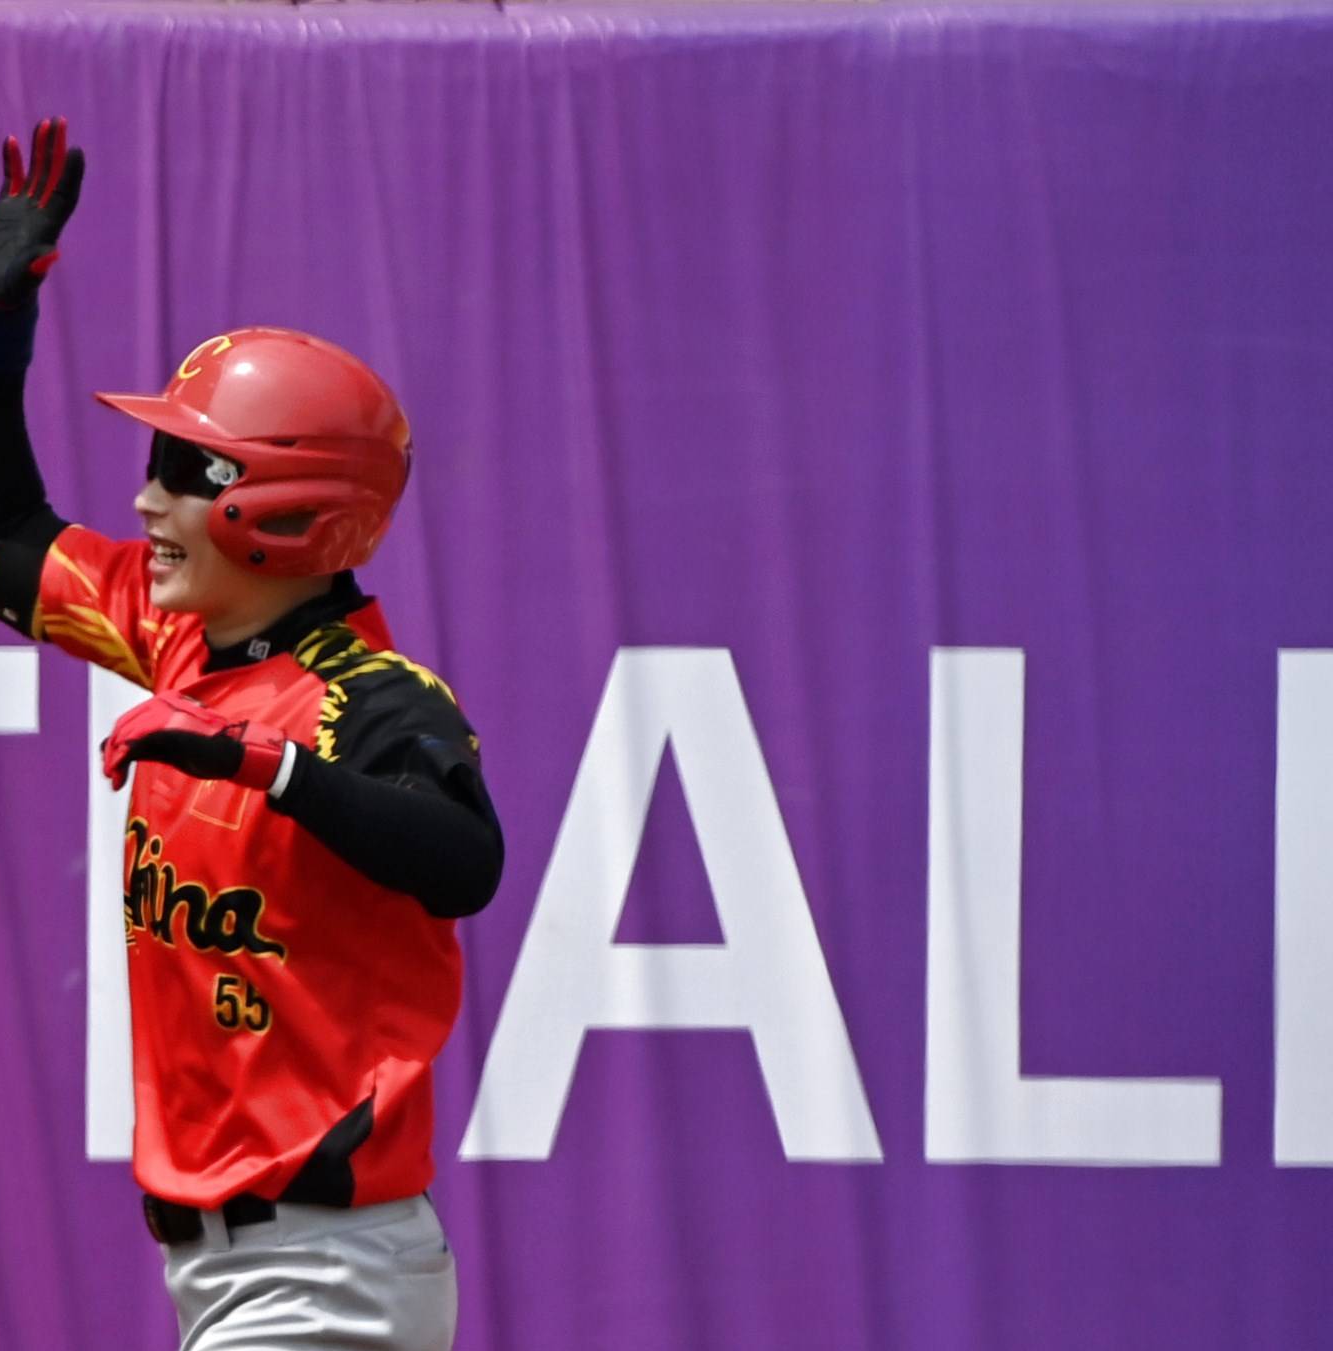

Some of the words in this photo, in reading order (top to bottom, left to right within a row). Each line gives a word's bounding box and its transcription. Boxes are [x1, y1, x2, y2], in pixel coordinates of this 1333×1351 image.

[178, 335, 233, 380] C
[124, 816, 287, 966] hina
[213, 972, 273, 1036] 55
